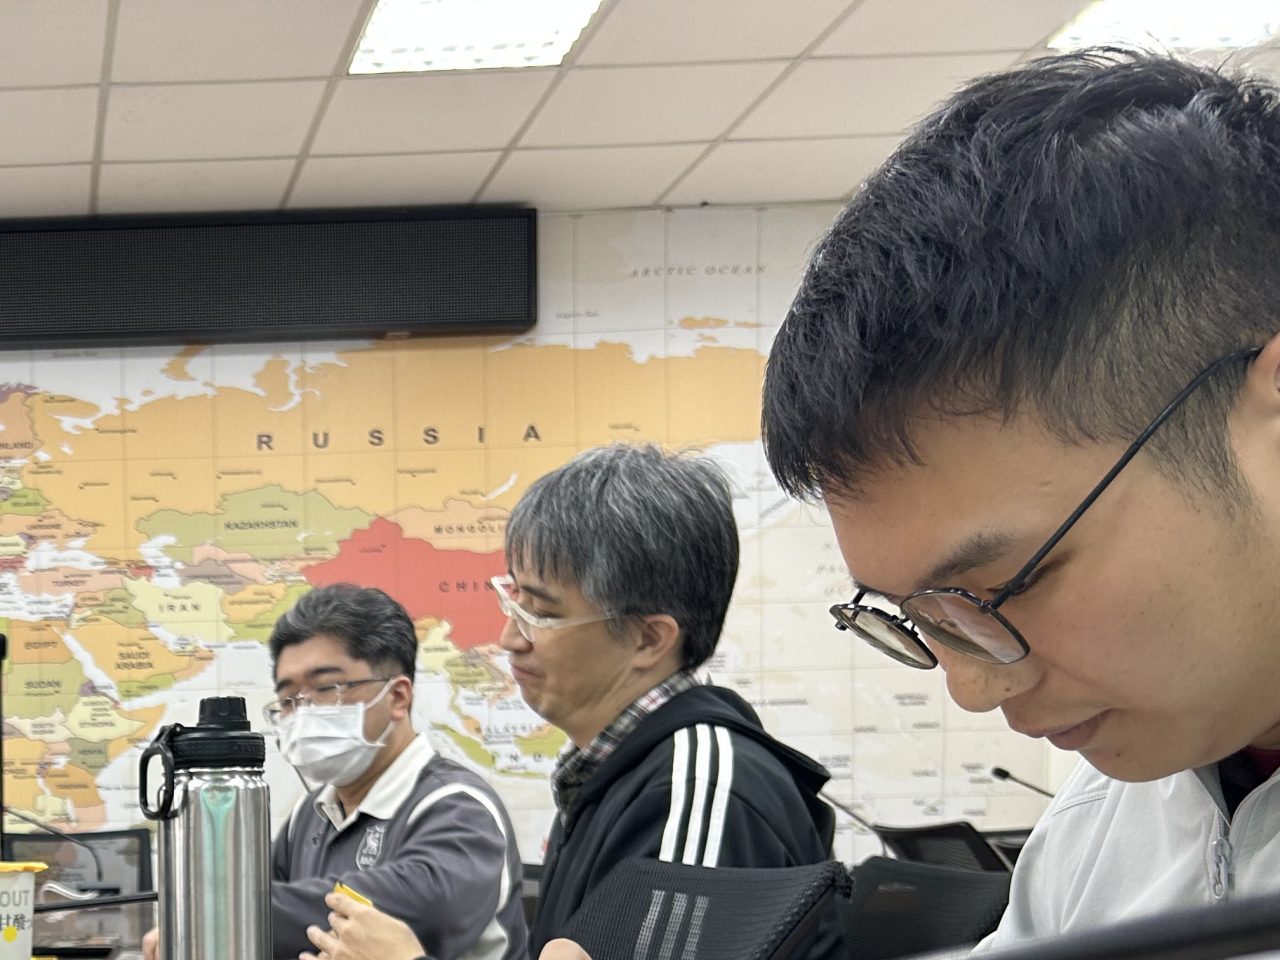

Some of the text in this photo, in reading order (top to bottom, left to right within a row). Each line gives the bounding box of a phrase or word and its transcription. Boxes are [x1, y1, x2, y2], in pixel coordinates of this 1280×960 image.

[257, 425, 542, 451] RUSSIA
[433, 523, 505, 535] MONGOLI
[438, 580, 495, 593] CHIN
[158, 602, 202, 613] IRAN
[23, 680, 62, 690] SUDAN
